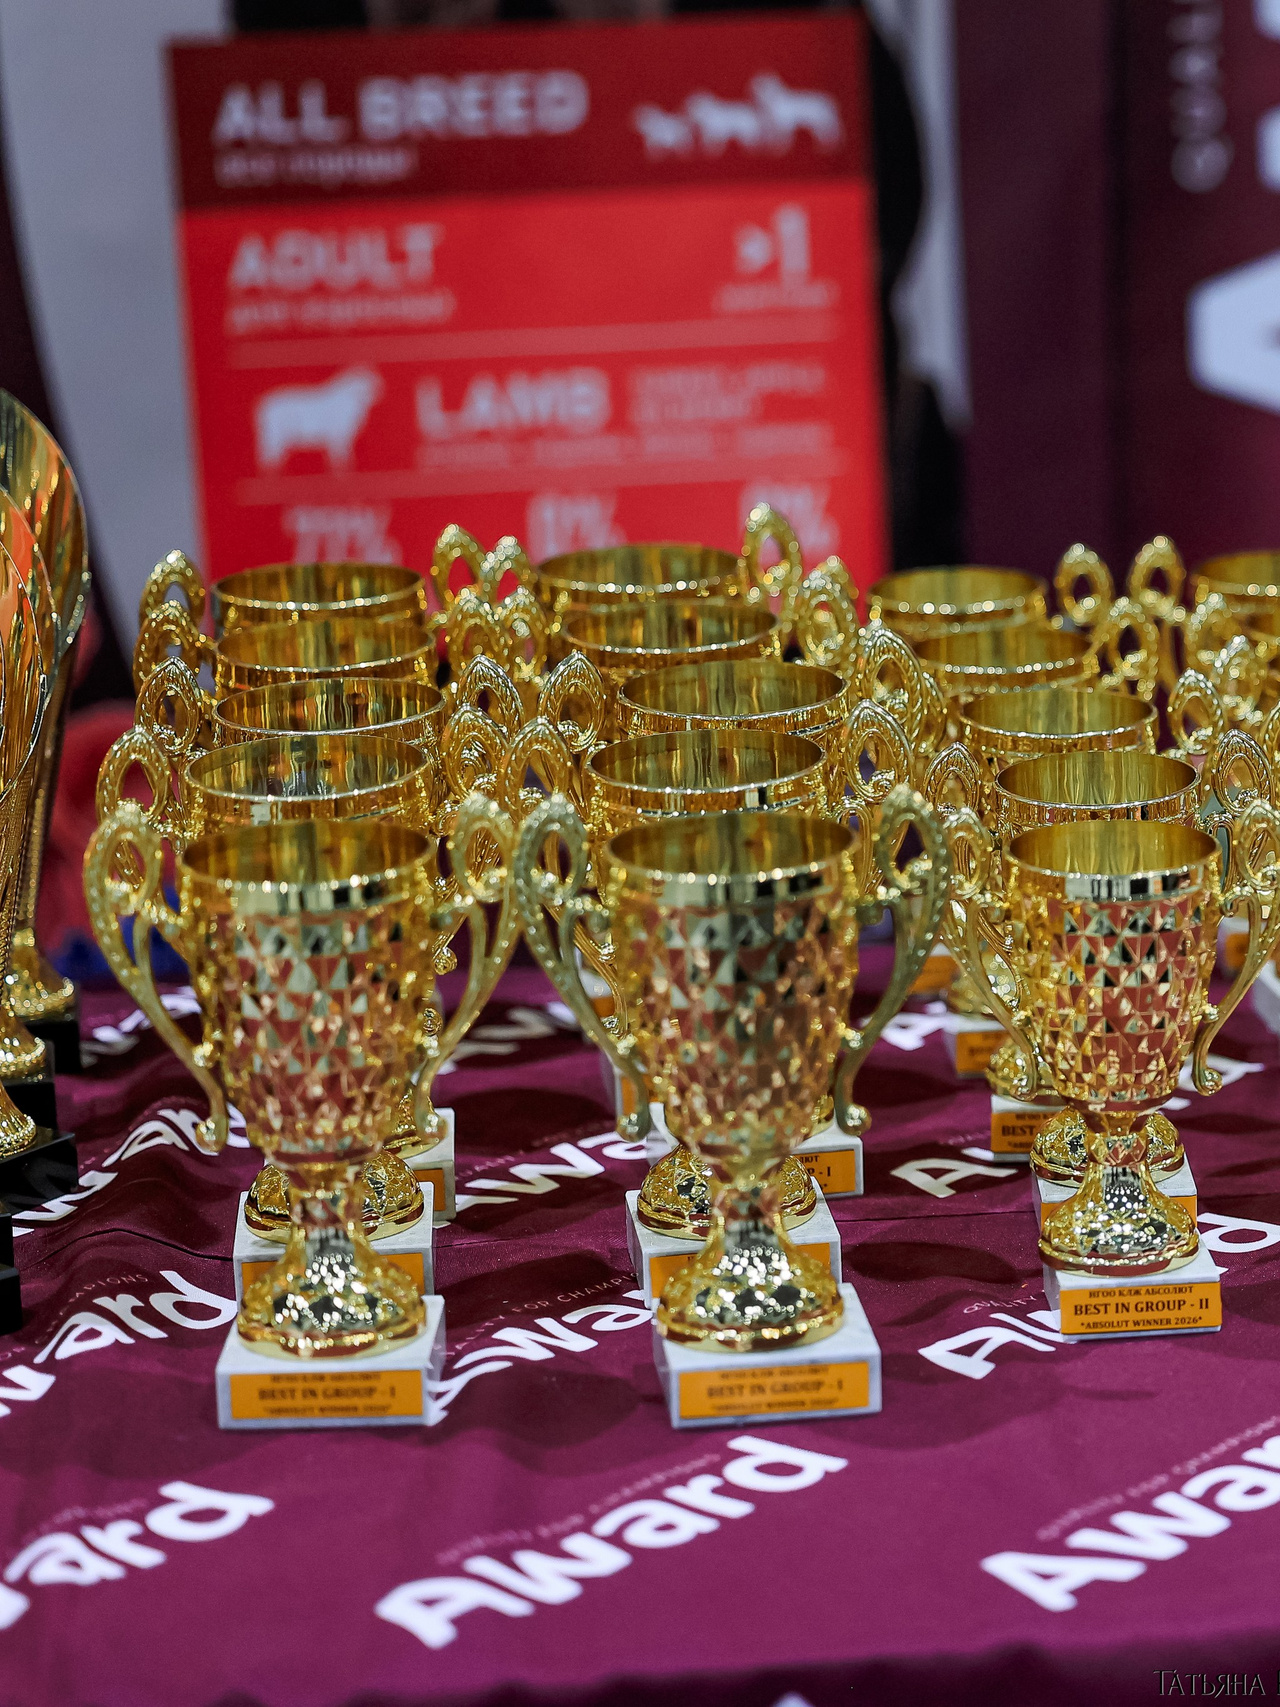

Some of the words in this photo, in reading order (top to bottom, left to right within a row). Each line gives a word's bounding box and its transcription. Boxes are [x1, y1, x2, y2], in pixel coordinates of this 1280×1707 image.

[216, 81, 346, 145] ALL
[357, 70, 589, 139] BREED
[229, 225, 446, 291] ADULT
[413, 367, 611, 440] LAMB
[1002, 1124, 1036, 1136] BEST
[557, 1272, 639, 1303] CHAMPIO
[1074, 1303, 1110, 1316] BEST
[1115, 1302, 1130, 1314] IN
[1135, 1300, 1186, 1313] GROUP
[1199, 1298, 1209, 1310] II
[1132, 1318, 1172, 1326] WINNER
[0, 1270, 237, 1416] ard
[0, 1480, 275, 1631] ard
[374, 1434, 850, 1650] Award
